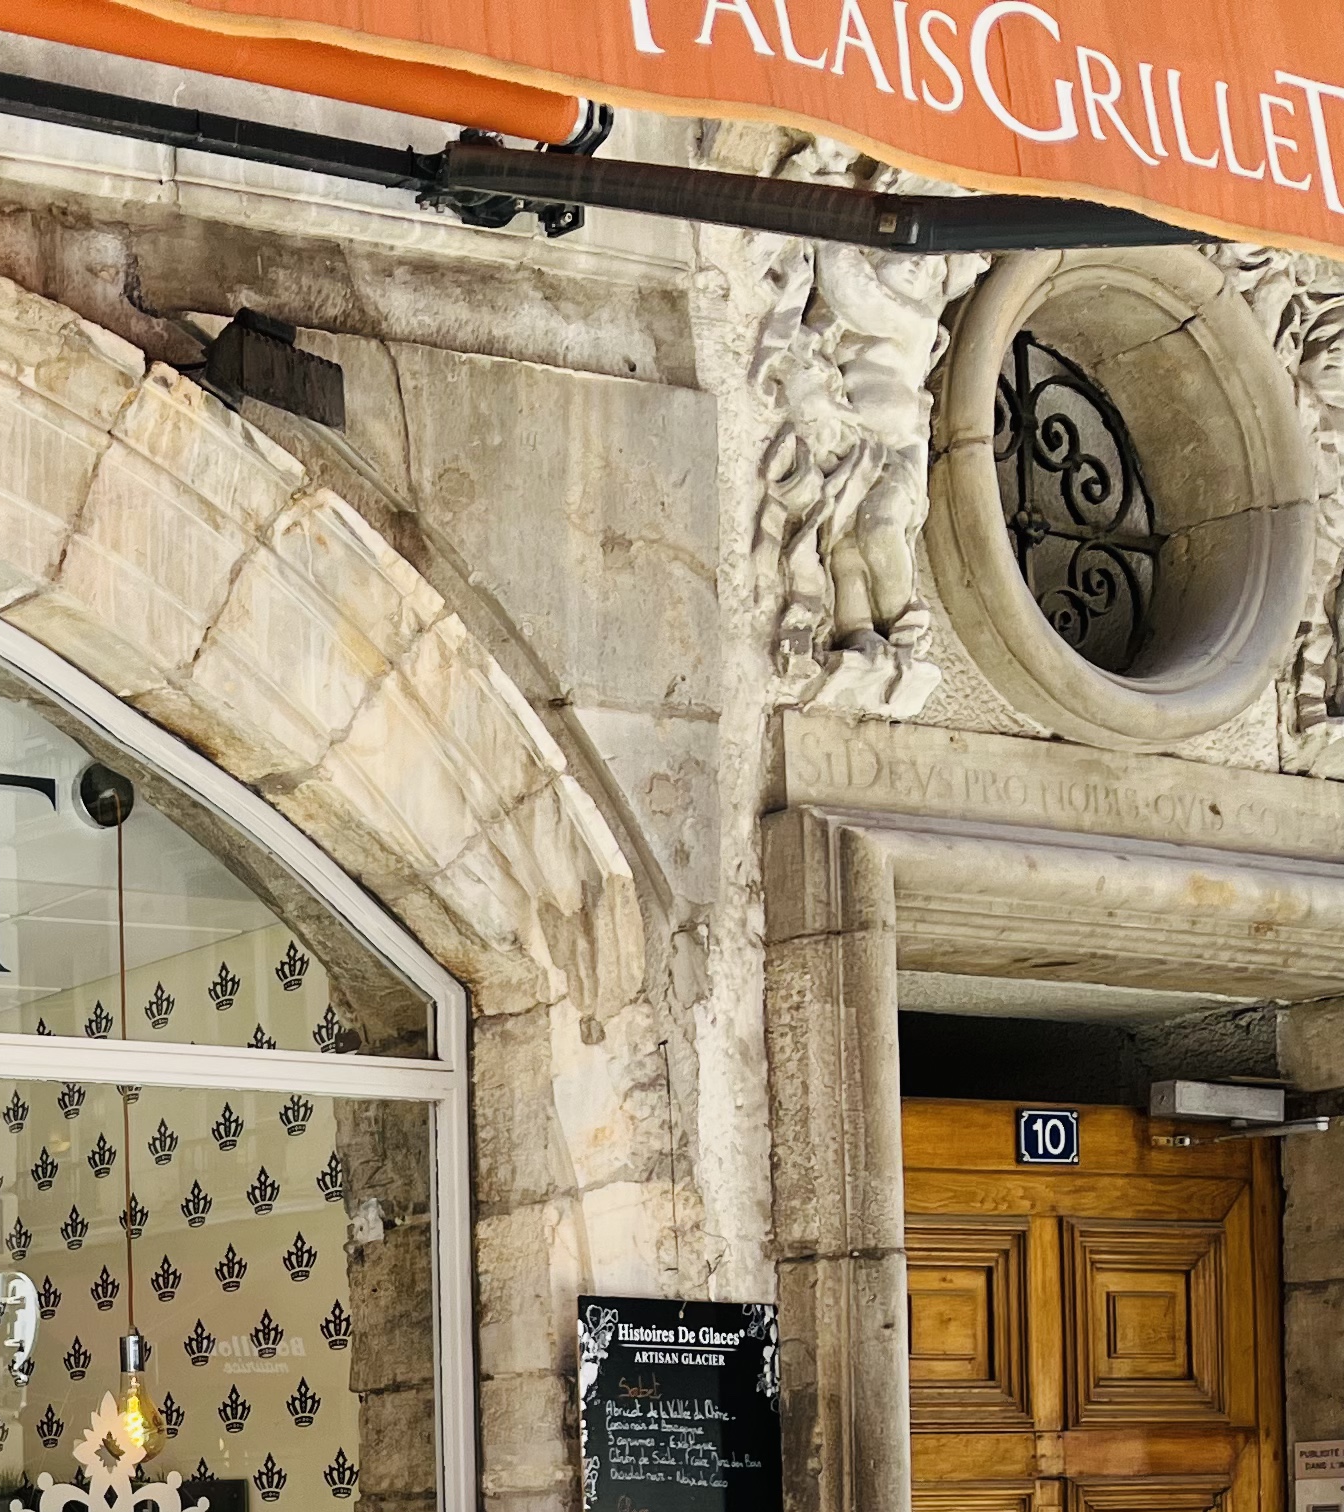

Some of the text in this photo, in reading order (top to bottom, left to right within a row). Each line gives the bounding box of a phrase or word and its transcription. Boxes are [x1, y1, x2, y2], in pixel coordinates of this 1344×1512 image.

[1032, 1118, 1065, 1155] 10
[618, 1324, 674, 1342] Histoires
[678, 1326, 695, 1344] De
[634, 1351, 725, 1366] ARTISAN GLACIER
